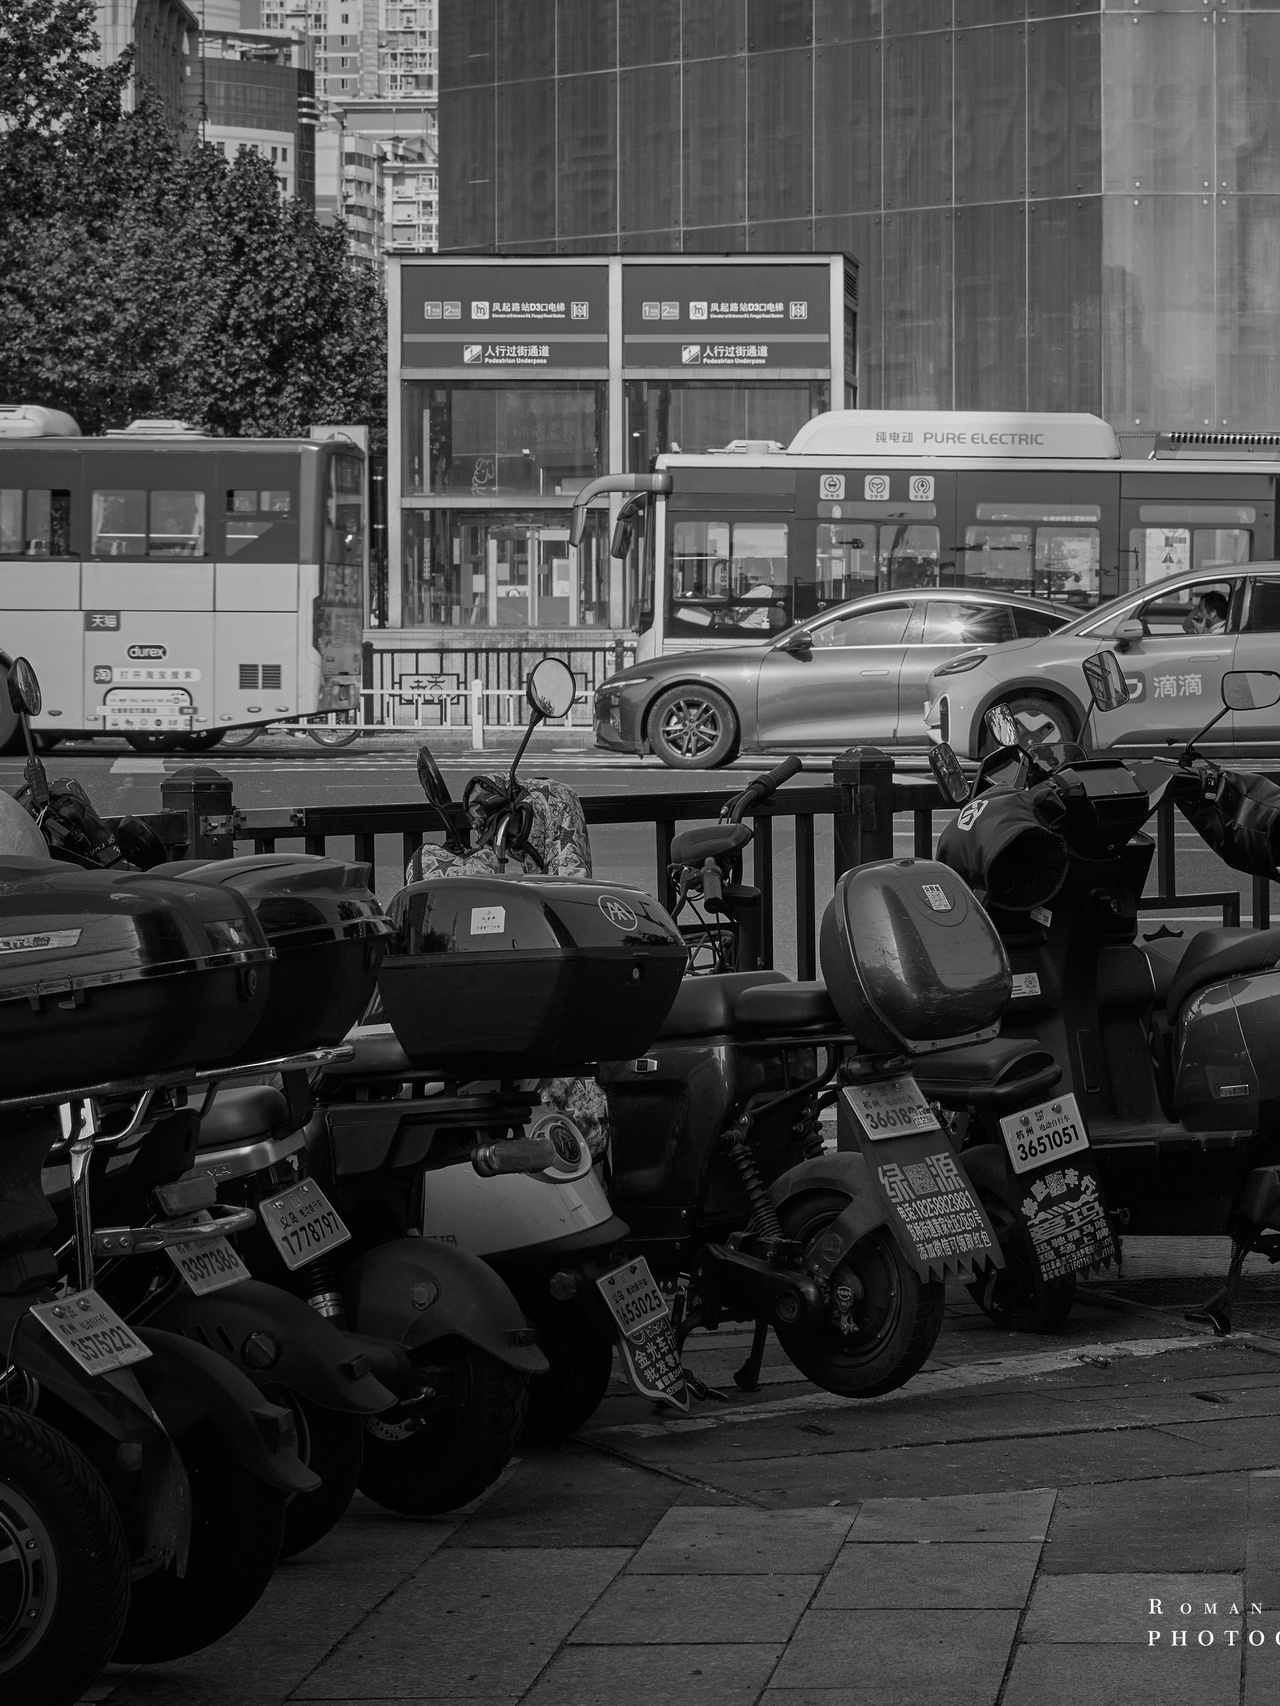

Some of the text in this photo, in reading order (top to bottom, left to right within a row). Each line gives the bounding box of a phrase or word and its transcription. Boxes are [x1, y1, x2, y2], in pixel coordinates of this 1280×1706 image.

[492, 302, 565, 312] 凤起路站D3口电梯
[710, 302, 783, 312] 凤起路站D3口电梯
[485, 346, 550, 357] 人行过街通道
[703, 346, 768, 357] 人行过街通道
[876, 431, 914, 444] 纯电动
[924, 432, 1044, 445] PURE ELECTRIC
[92, 614, 117, 628] 天猫
[130, 646, 166, 658] durex
[1154, 673, 1202, 698] 滴滴
[865, 1104, 924, 1130] 36618
[1016, 1114, 1070, 1140] 杭州 电动自行车
[1017, 1124, 1079, 1161] 3651051
[280, 1200, 322, 1230] 义乌 电动自行车
[896, 1190, 975, 1222] 电话:18258823881
[282, 1211, 339, 1255] 1778797
[1038, 1228, 1110, 1263] 现场上牌
[182, 1247, 239, 1281] 3397386
[613, 1278, 648, 1304] 义乌 电动自行车
[616, 1290, 662, 1326] 1653025
[71, 1326, 136, 1361] 3575221
[635, 1331, 675, 1369] 金光车行
